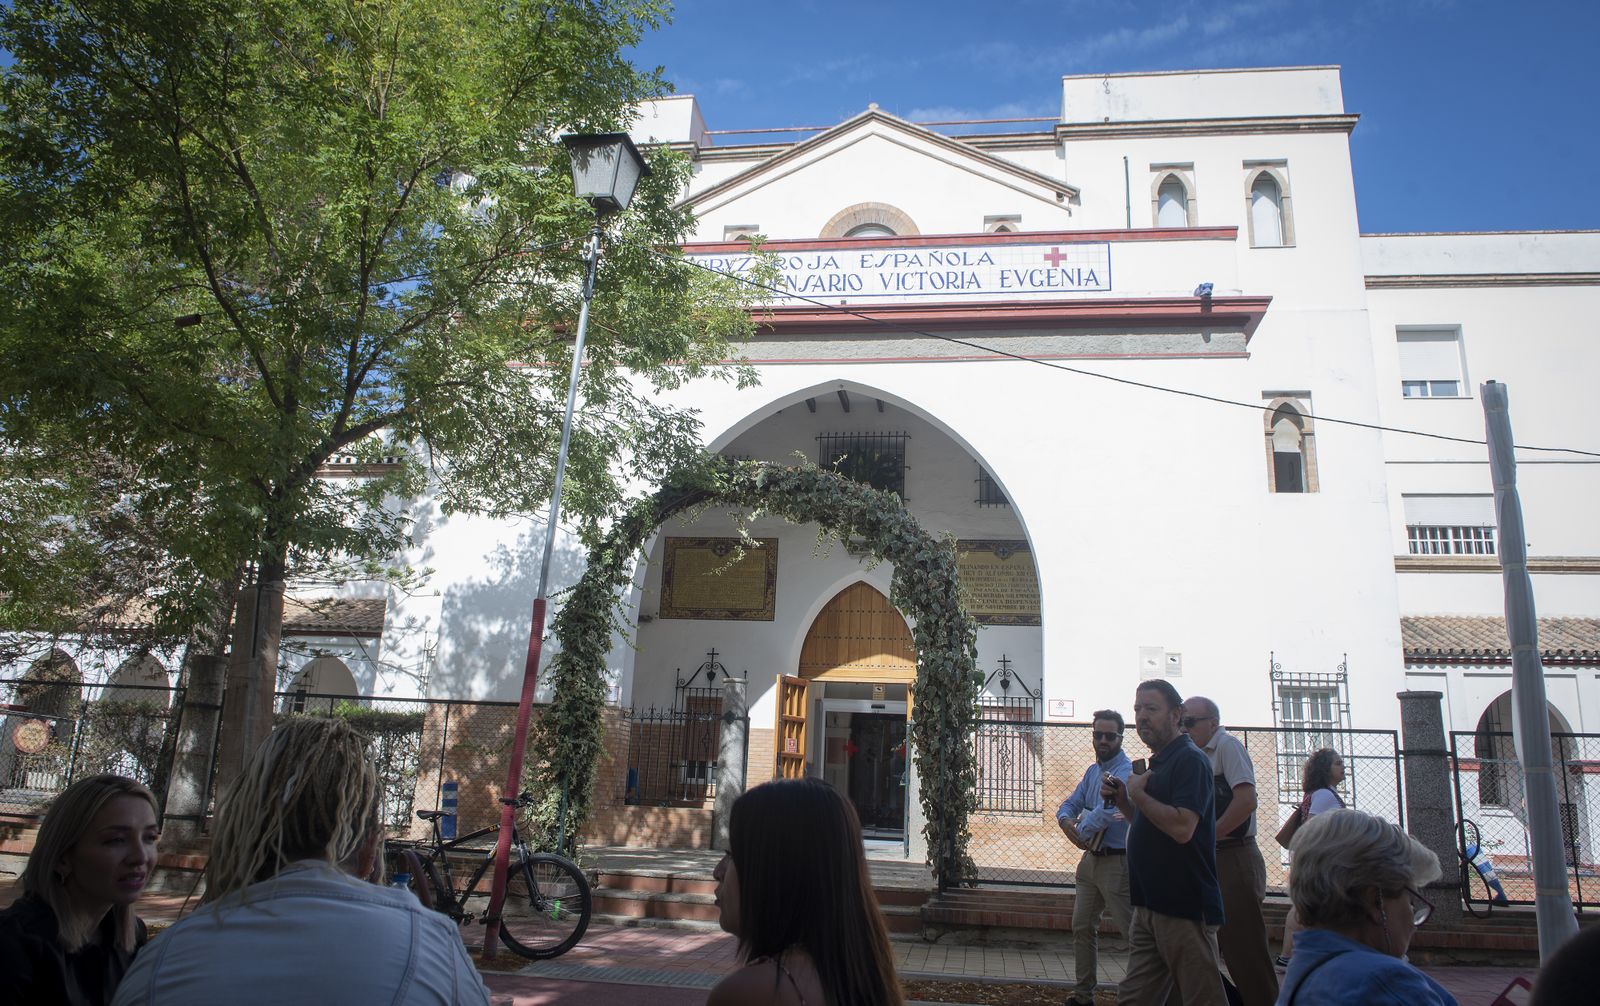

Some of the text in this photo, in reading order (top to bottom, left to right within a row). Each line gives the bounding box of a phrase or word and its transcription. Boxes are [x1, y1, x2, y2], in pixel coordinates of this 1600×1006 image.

[773, 255, 840, 270] ROJA
[860, 250, 995, 268] ESPAÑOLA
[879, 271, 982, 291] VICTORIA
[999, 268, 1100, 288] EVGENIA
